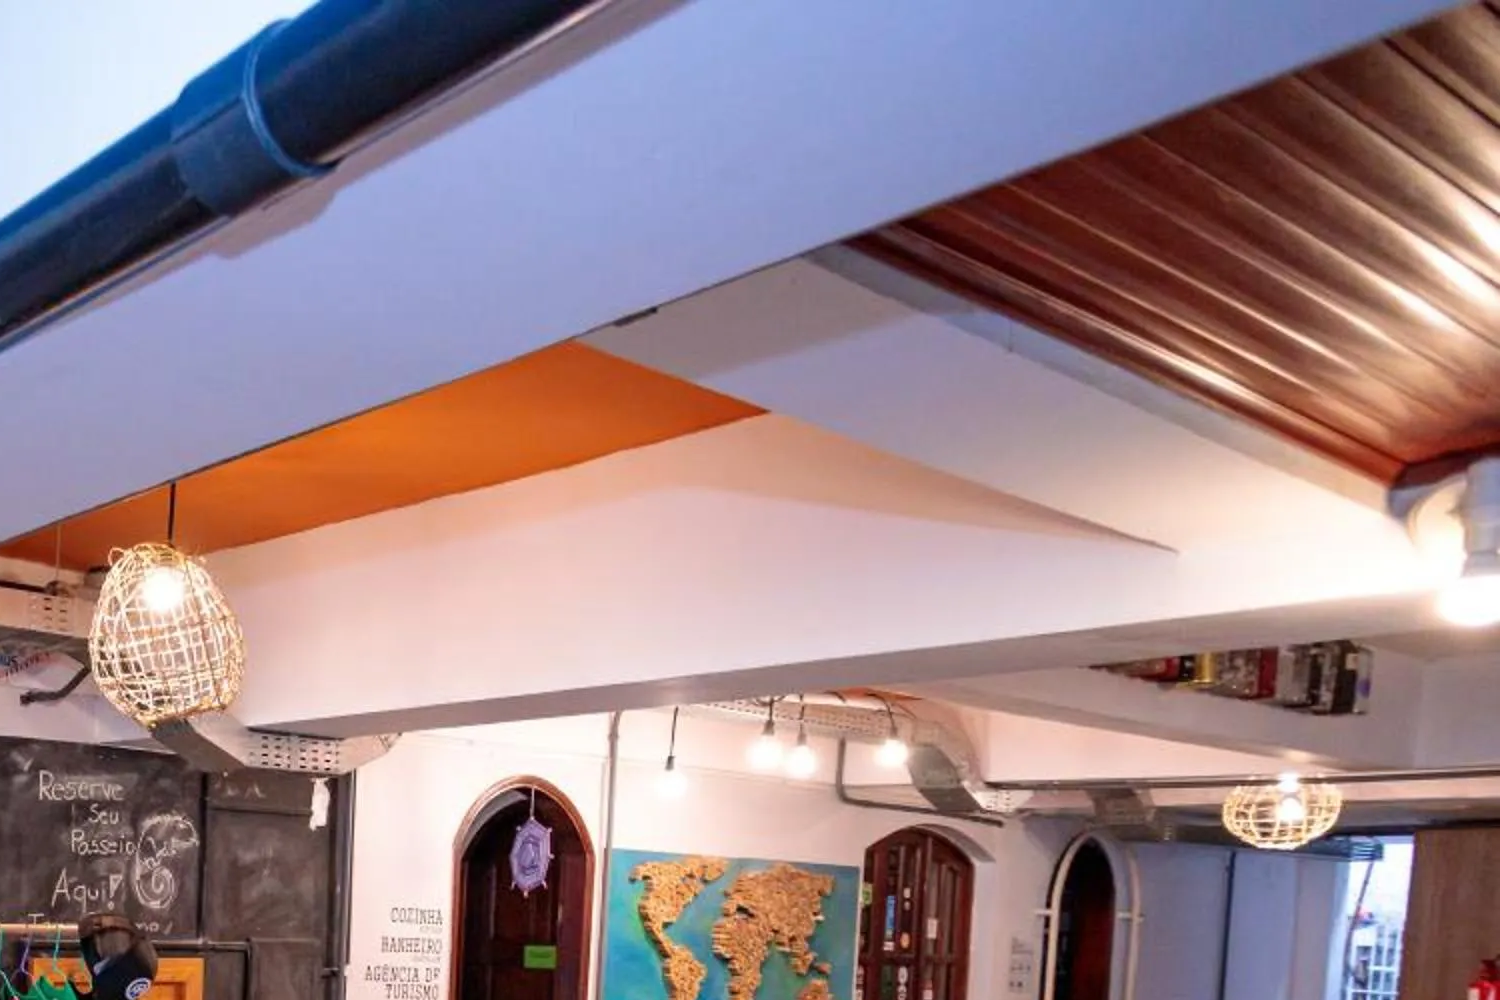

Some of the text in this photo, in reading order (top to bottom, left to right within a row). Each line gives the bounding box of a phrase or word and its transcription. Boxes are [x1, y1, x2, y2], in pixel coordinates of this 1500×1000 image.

[38, 770, 125, 801] Reserve
[88, 803, 120, 825] Seu
[71, 829, 136, 855] Passeio
[390, 907, 443, 925] COZINHA
[381, 936, 442, 954] BANHEIRO
[365, 963, 420, 983] AGÊNCIA
[385, 983, 439, 1000] TURISMO
